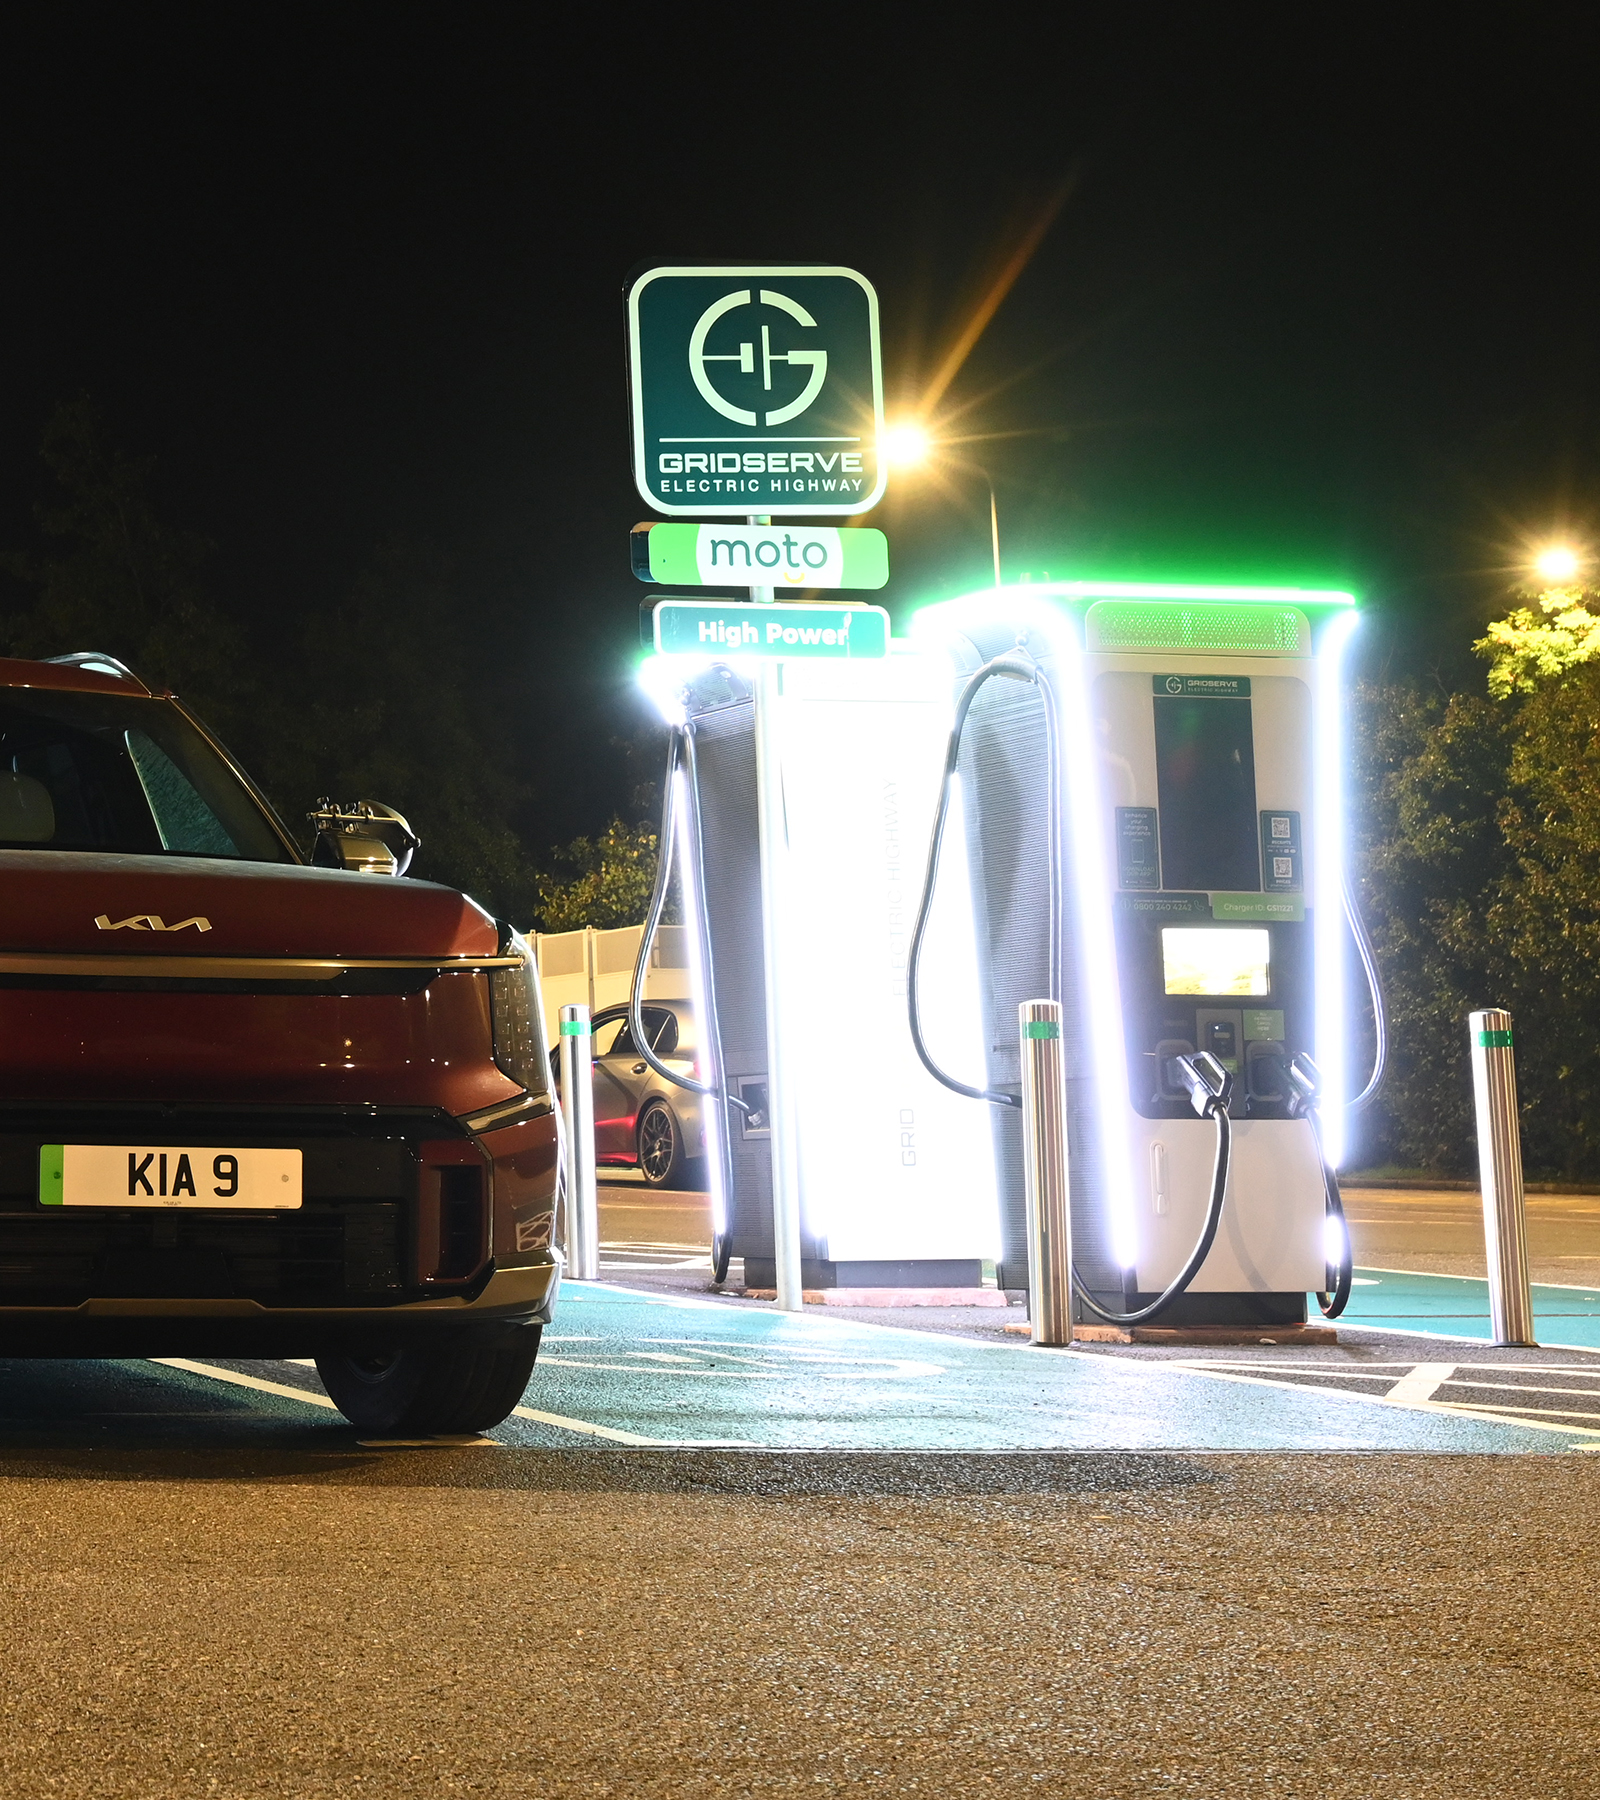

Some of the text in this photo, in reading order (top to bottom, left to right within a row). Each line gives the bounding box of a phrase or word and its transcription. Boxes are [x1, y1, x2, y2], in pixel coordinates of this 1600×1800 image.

[658, 451, 864, 475] GRIDSERVE
[660, 478, 864, 493] ELECTRIC HIGHWAY
[710, 533, 828, 569] moto
[697, 619, 849, 648] High Power
[1187, 679, 1238, 688] GRIDSERVE
[1155, 903, 1171, 911] 240
[1223, 902, 1254, 913] Charger
[899, 1108, 917, 1167] GRID
[128, 1152, 239, 1197] KIA 9
